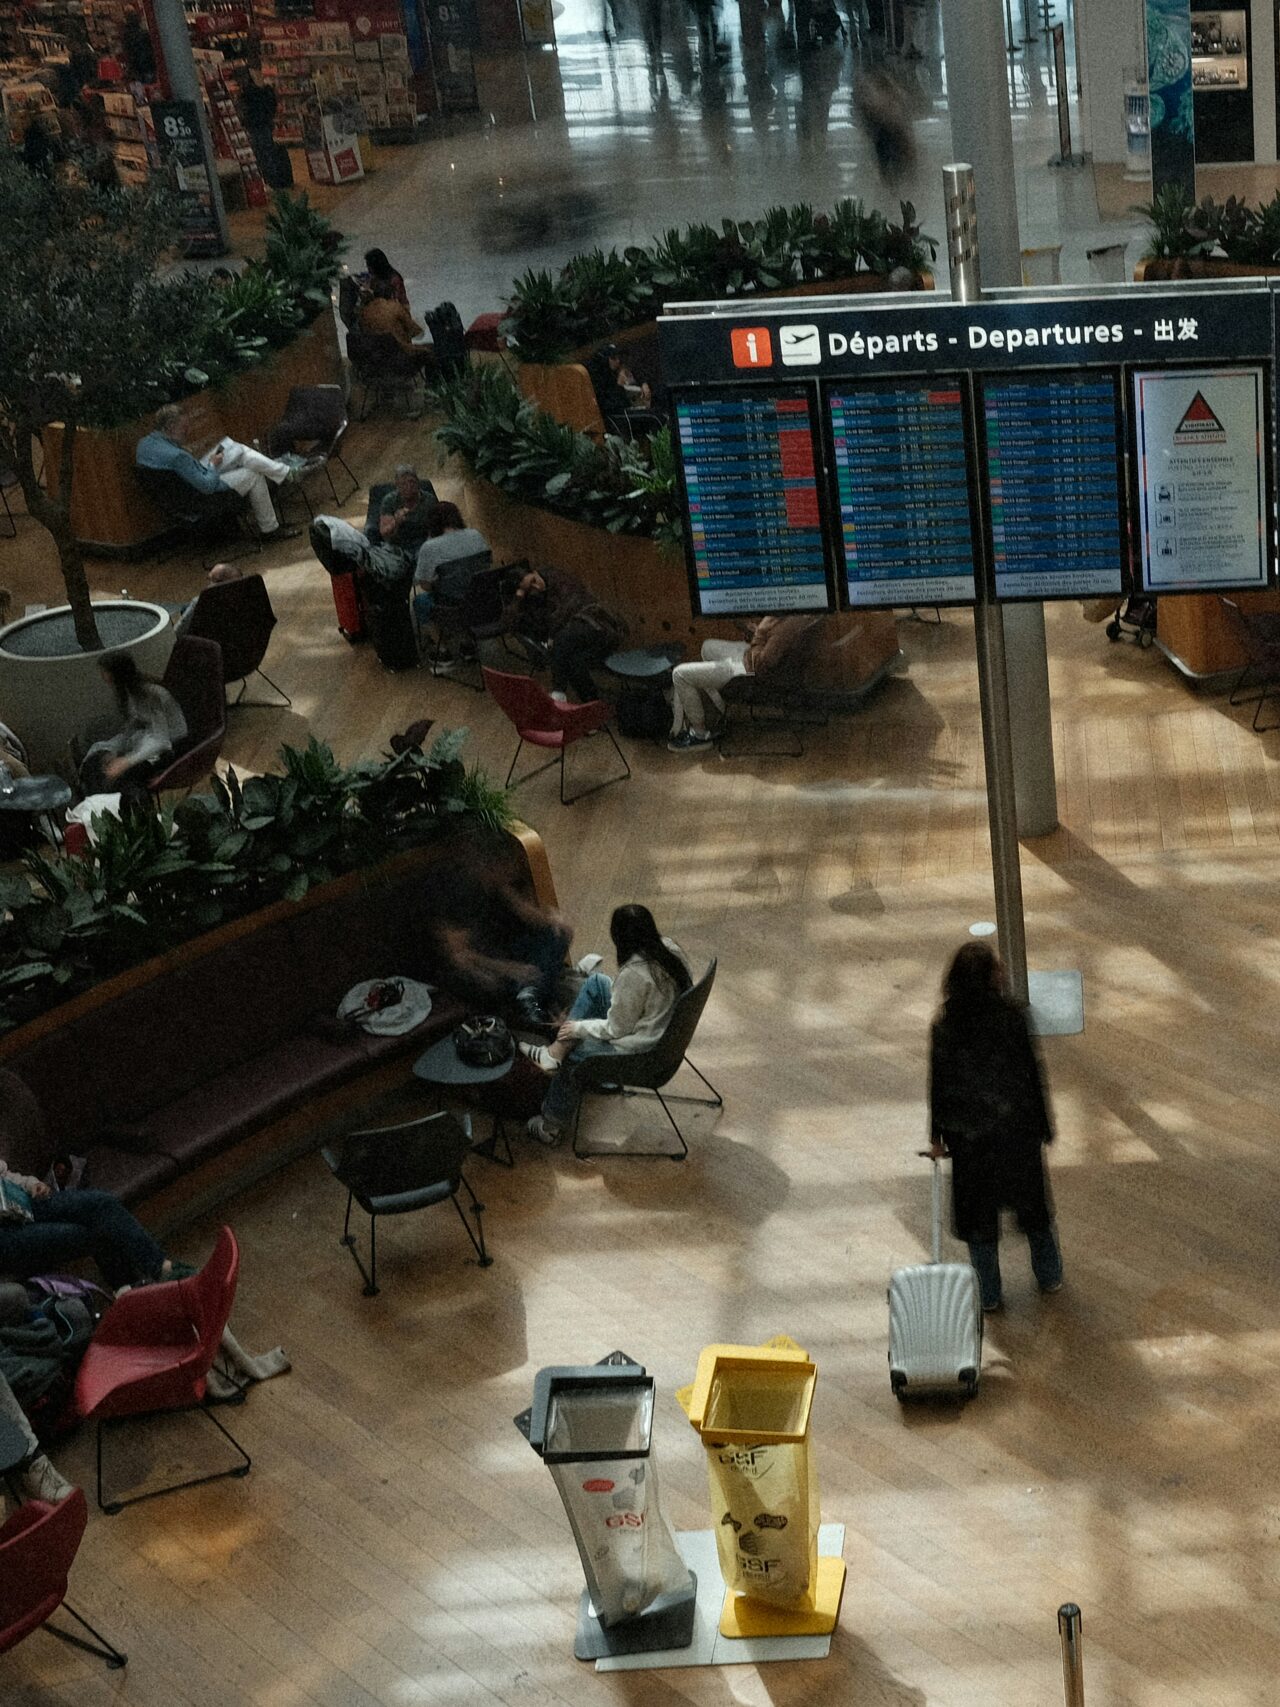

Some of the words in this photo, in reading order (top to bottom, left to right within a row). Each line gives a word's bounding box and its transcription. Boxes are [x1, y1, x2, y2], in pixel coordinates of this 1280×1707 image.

[829, 331, 939, 360] Départs
[968, 322, 1125, 353] Departures
[1153, 318, 1199, 342] 出发
